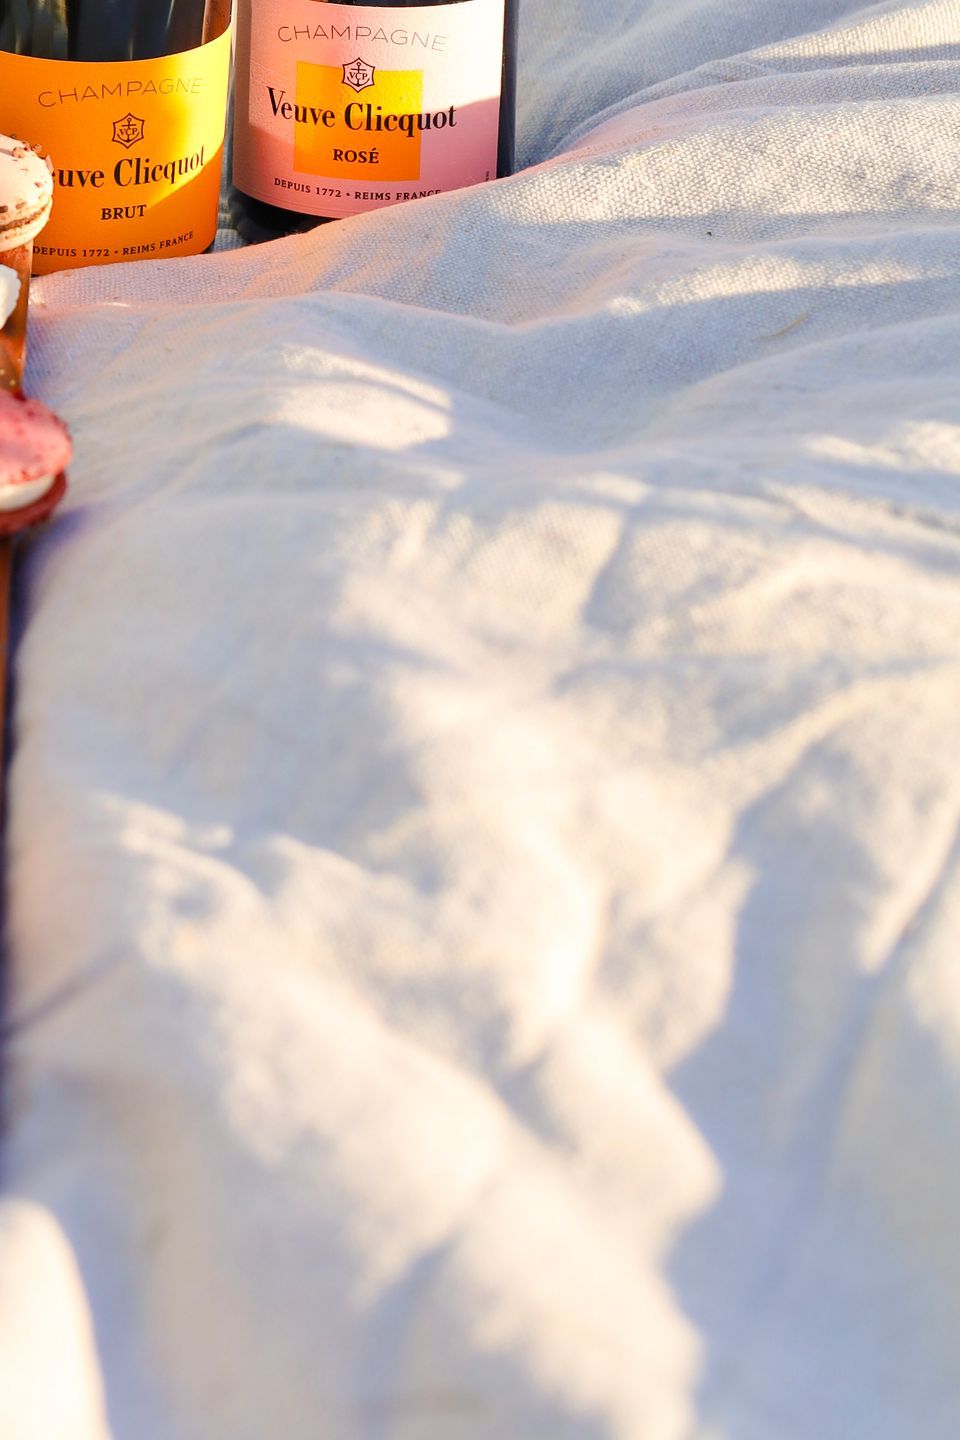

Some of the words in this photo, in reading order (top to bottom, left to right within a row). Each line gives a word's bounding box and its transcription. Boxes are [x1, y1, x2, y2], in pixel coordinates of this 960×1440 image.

[277, 24, 448, 52] CHAMPAGNE
[349, 71, 368, 81] VCP
[38, 77, 203, 108] CHAMPAGNE
[266, 86, 336, 128] Veuve
[344, 102, 457, 138] Clicquot
[119, 127, 138, 137] VCP
[52, 166, 105, 188] uve
[113, 144, 206, 188] Clicquot
[332, 147, 380, 164] ROSÉ
[274, 177, 311, 194] DEPUIS
[316, 186, 341, 198] 1772
[355, 191, 391, 201] REIMS
[100, 204, 147, 221] BRUT
[33, 245, 76, 257] DEPUIS
[82, 248, 110, 258] 1772
[123, 243, 156, 256] REIMS
[159, 230, 194, 249] FRANCE
